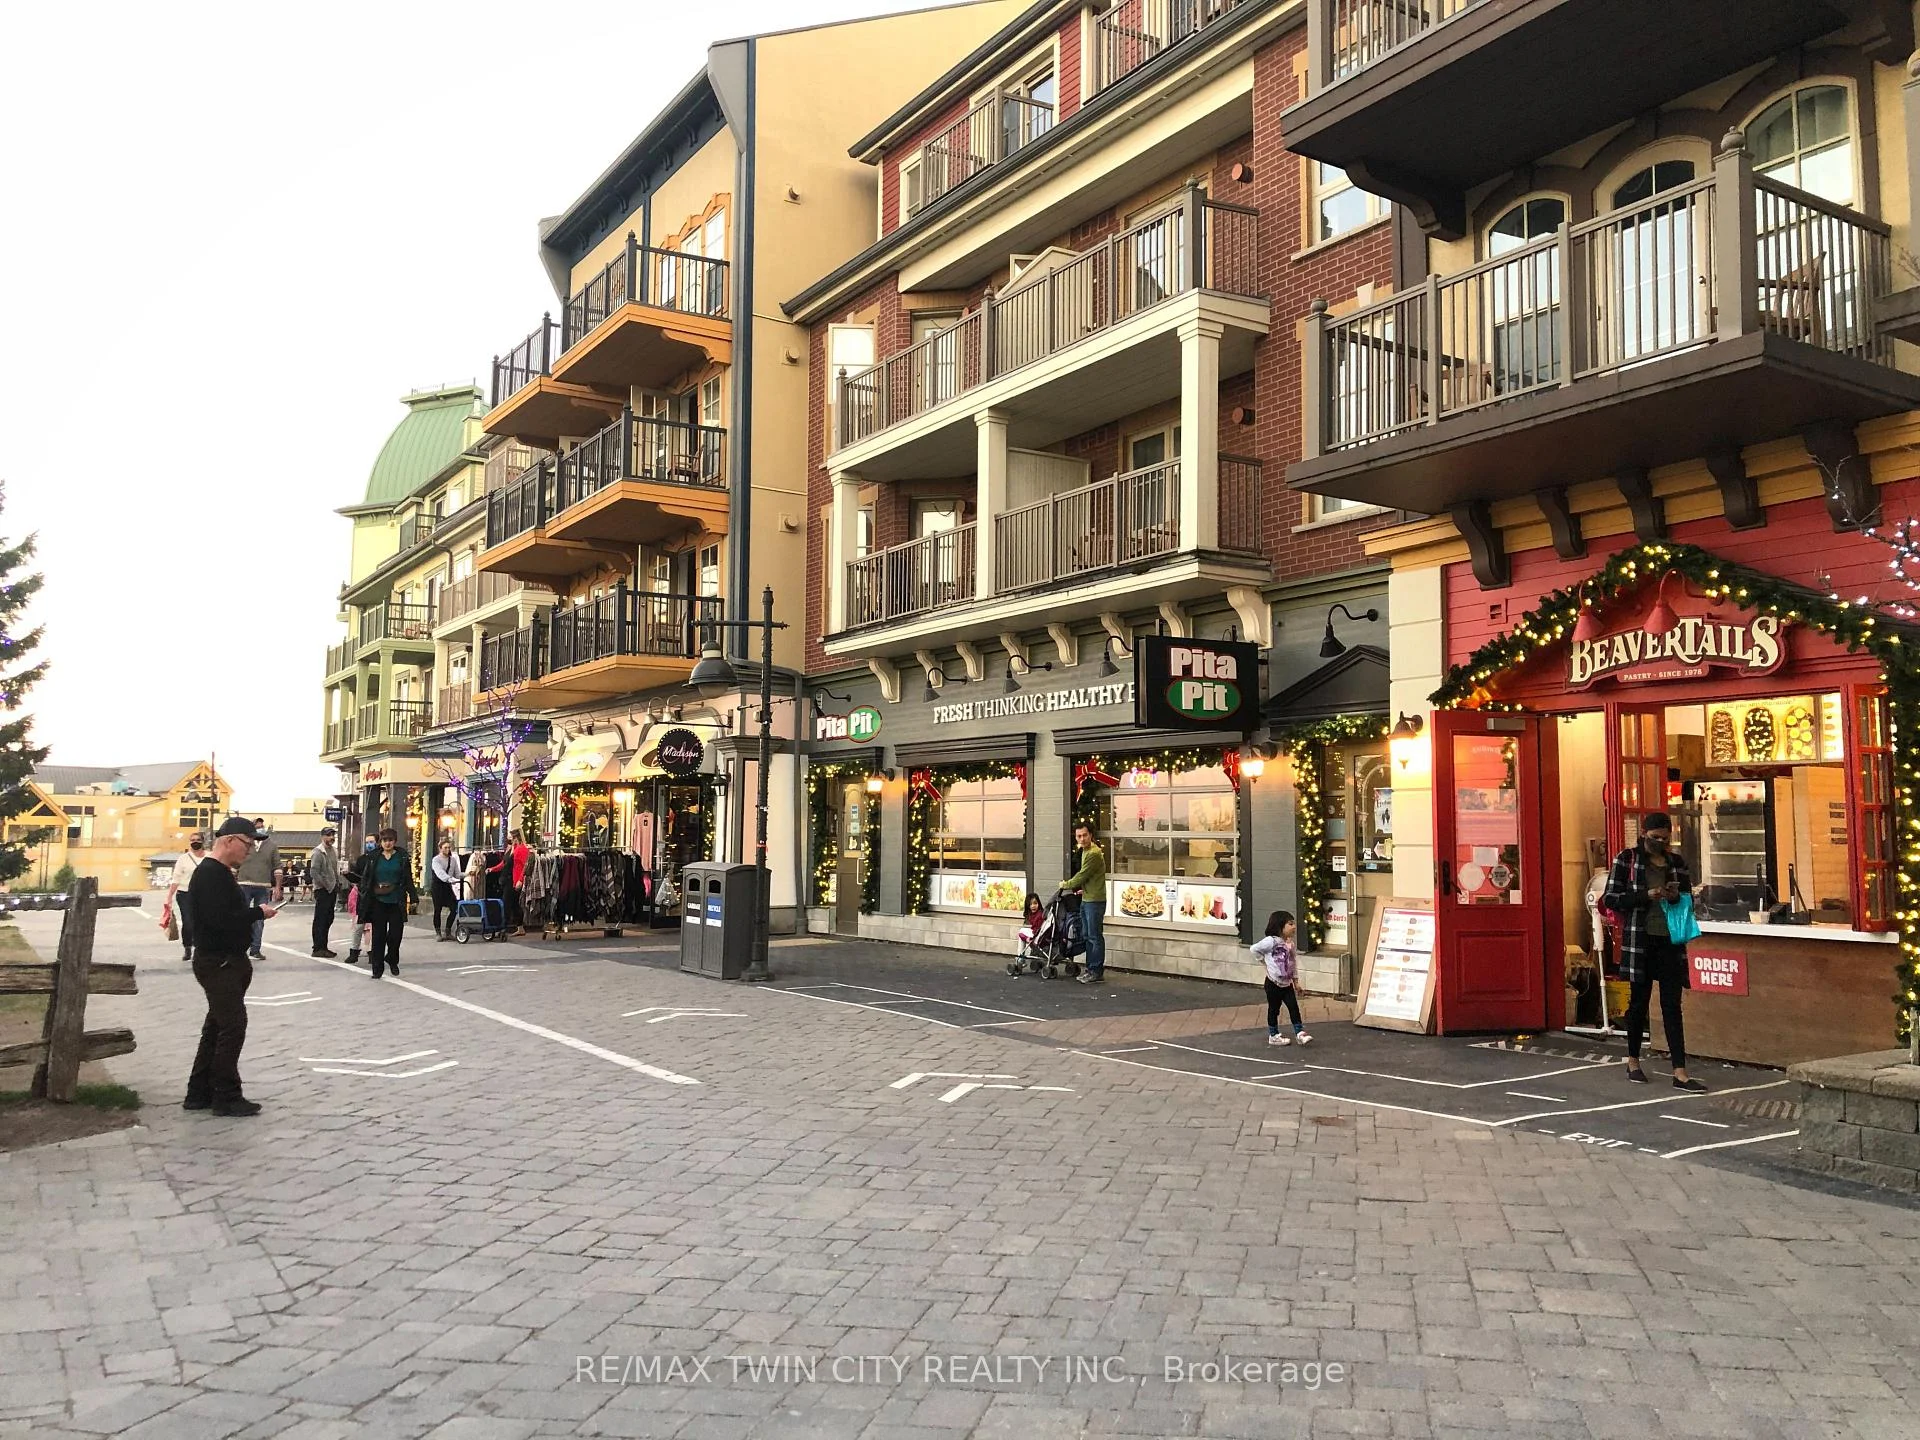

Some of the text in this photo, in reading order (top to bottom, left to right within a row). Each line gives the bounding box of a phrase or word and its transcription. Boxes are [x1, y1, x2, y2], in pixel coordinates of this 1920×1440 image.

[1570, 616, 1778, 682] BEAVERTAILS
[1171, 647, 1237, 679] Pita
[1623, 672, 1652, 681] PASTRY
[933, 705, 975, 724] FRESH
[975, 693, 1045, 720] THINKING
[1046, 683, 1124, 711] HEALTHY
[1181, 681, 1228, 711] Pit
[816, 712, 873, 739] Pita Pit
[662, 744, 700, 760] Madison
[1694, 956, 1739, 973] ORDER
[1700, 971, 1734, 987] HERE
